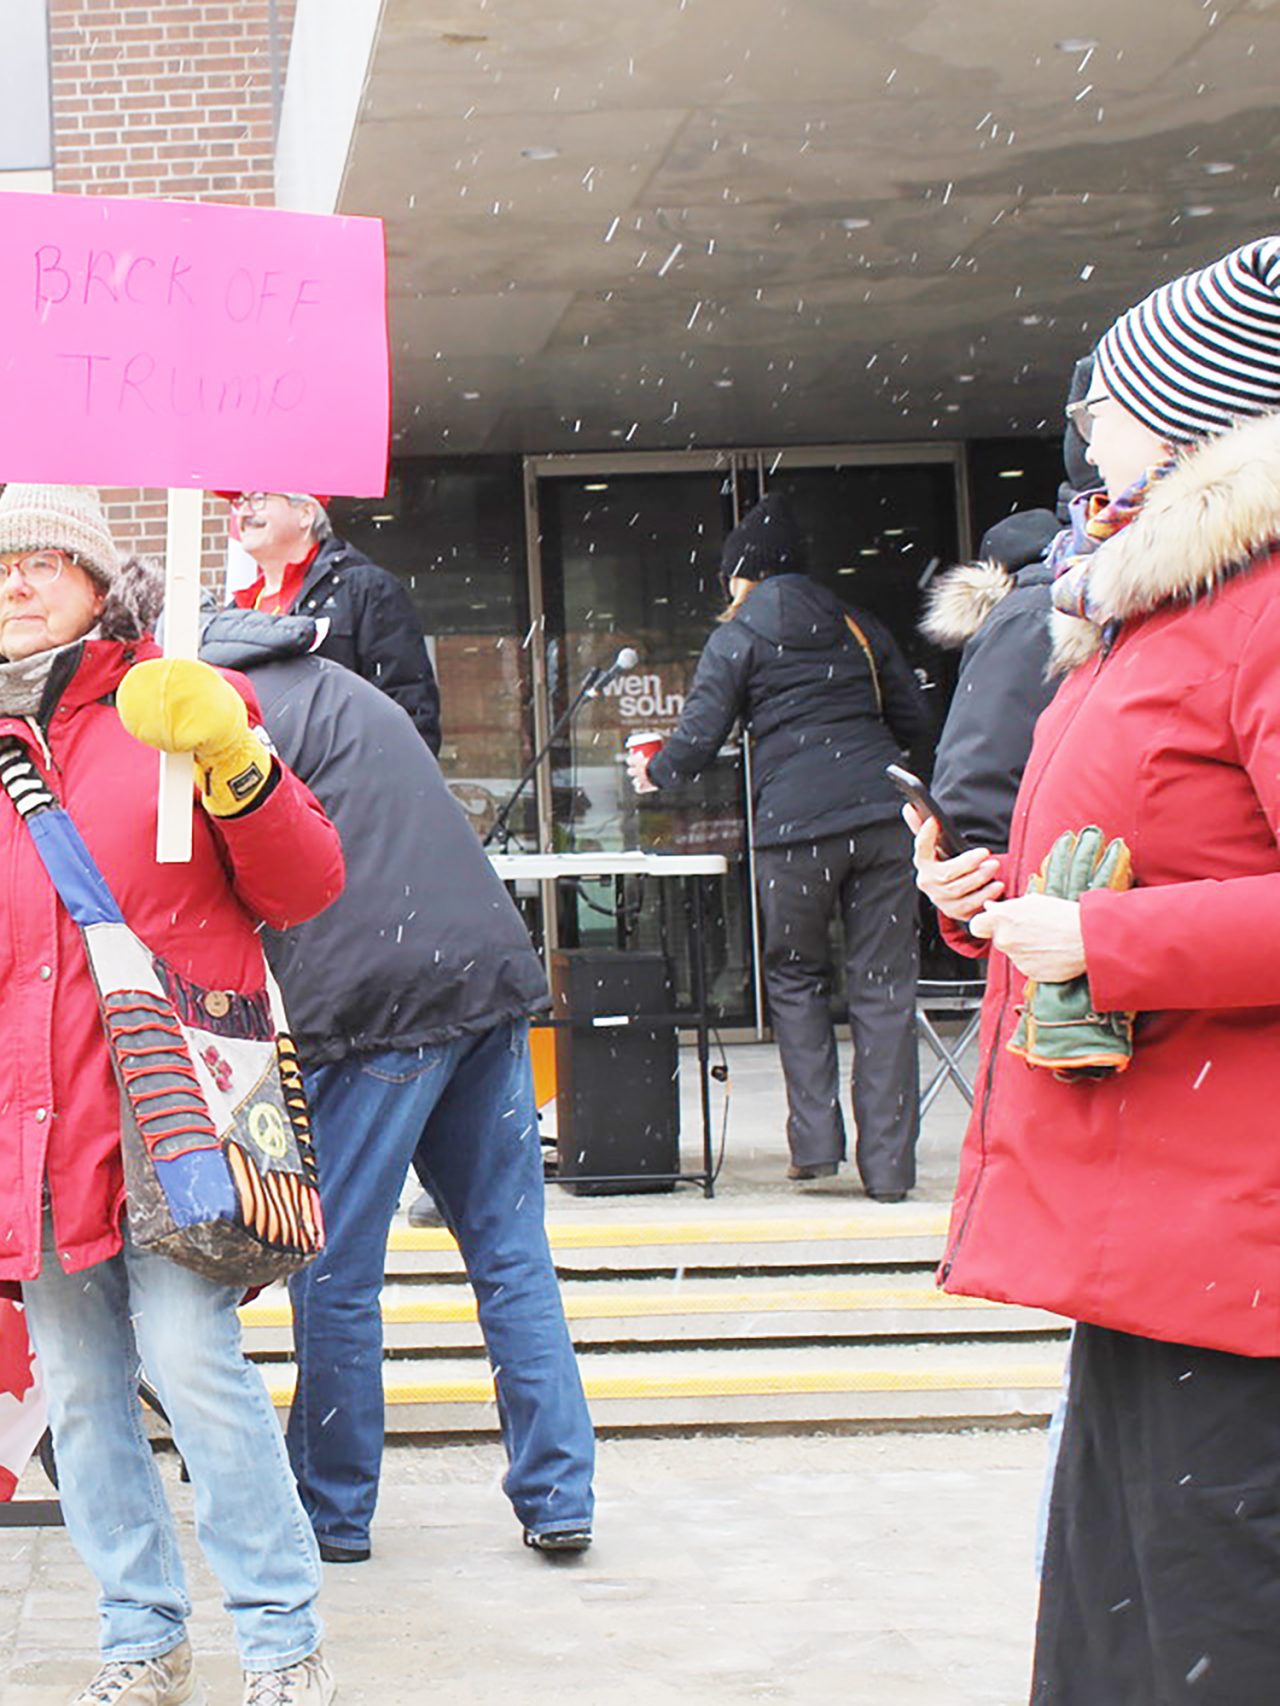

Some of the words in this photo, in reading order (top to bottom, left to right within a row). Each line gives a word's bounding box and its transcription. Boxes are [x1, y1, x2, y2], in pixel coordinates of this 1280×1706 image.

[33, 244, 194, 312] BACK
[224, 266, 322, 325] OFF
[602, 673, 661, 697] wen
